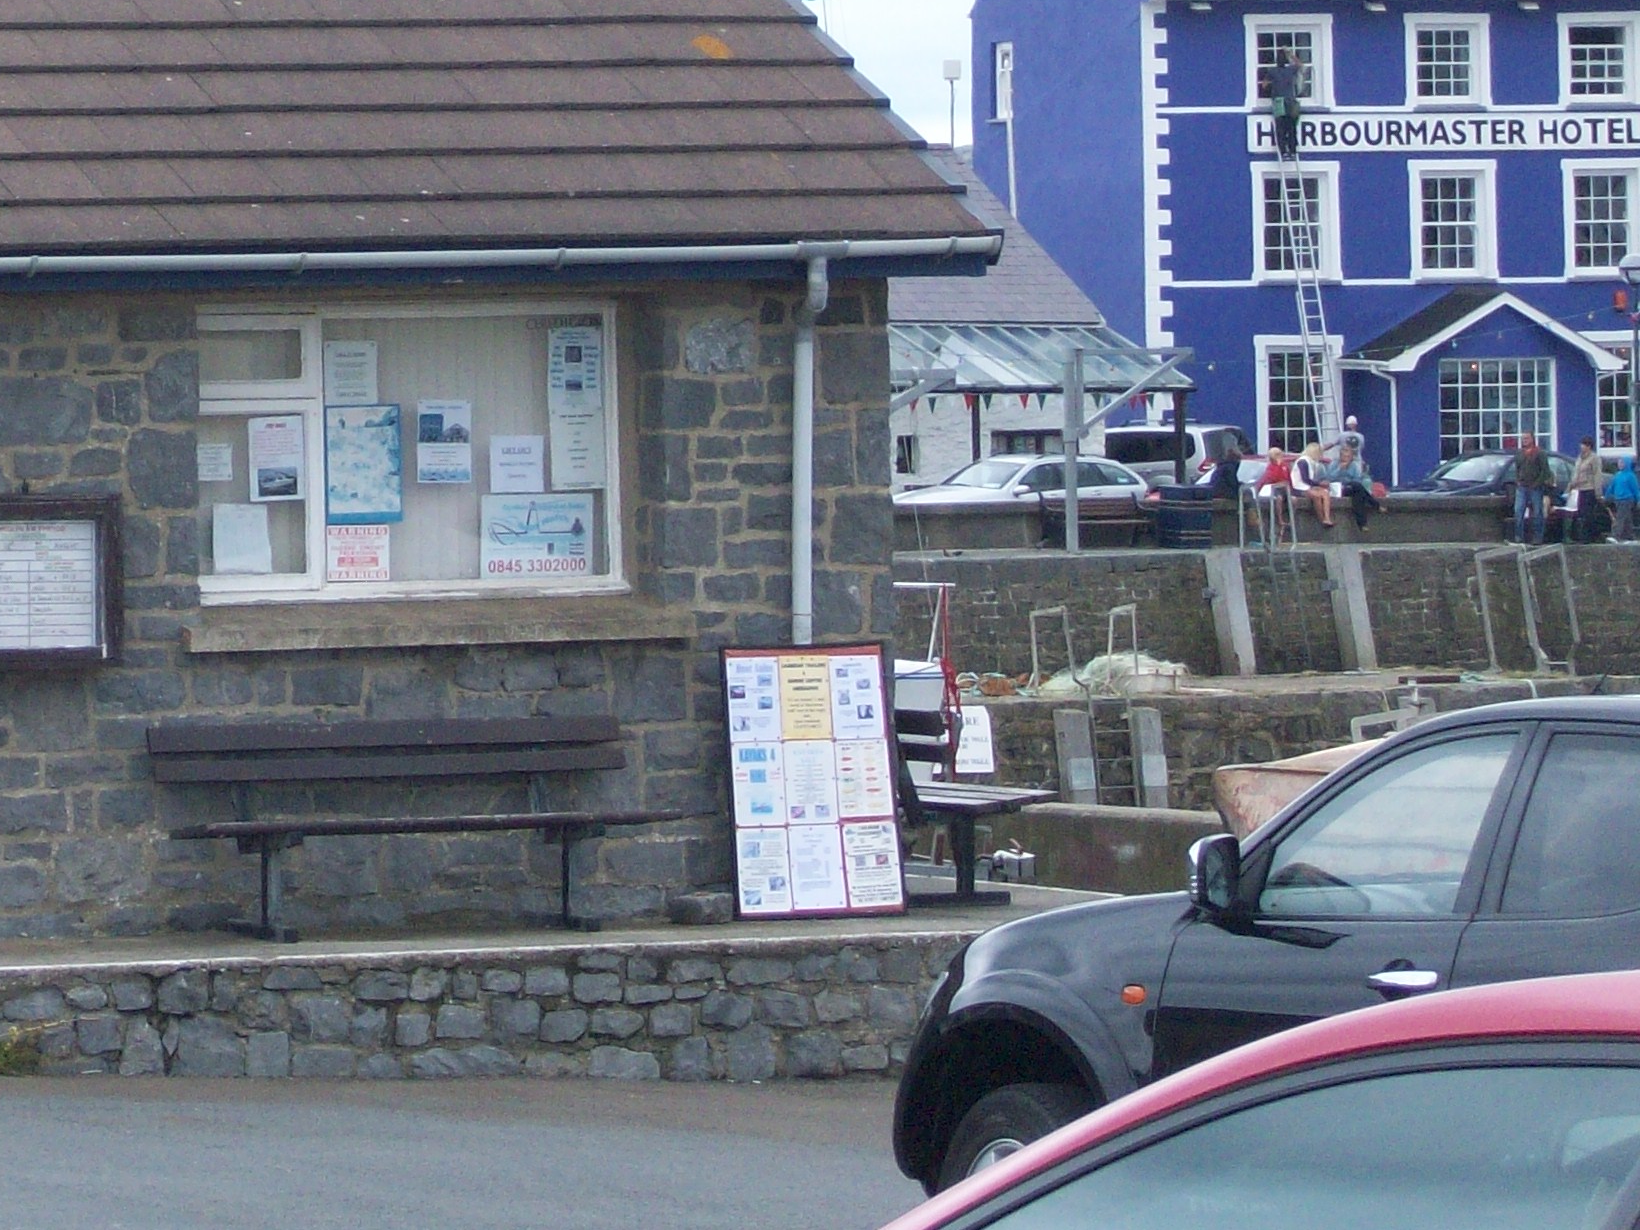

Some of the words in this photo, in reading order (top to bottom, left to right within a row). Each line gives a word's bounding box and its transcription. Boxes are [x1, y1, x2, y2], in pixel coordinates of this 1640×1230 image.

[1256, 119, 1527, 147] HRBOURMASTER
[488, 559, 523, 573] 0845
[525, 557, 587, 573] 3302000
